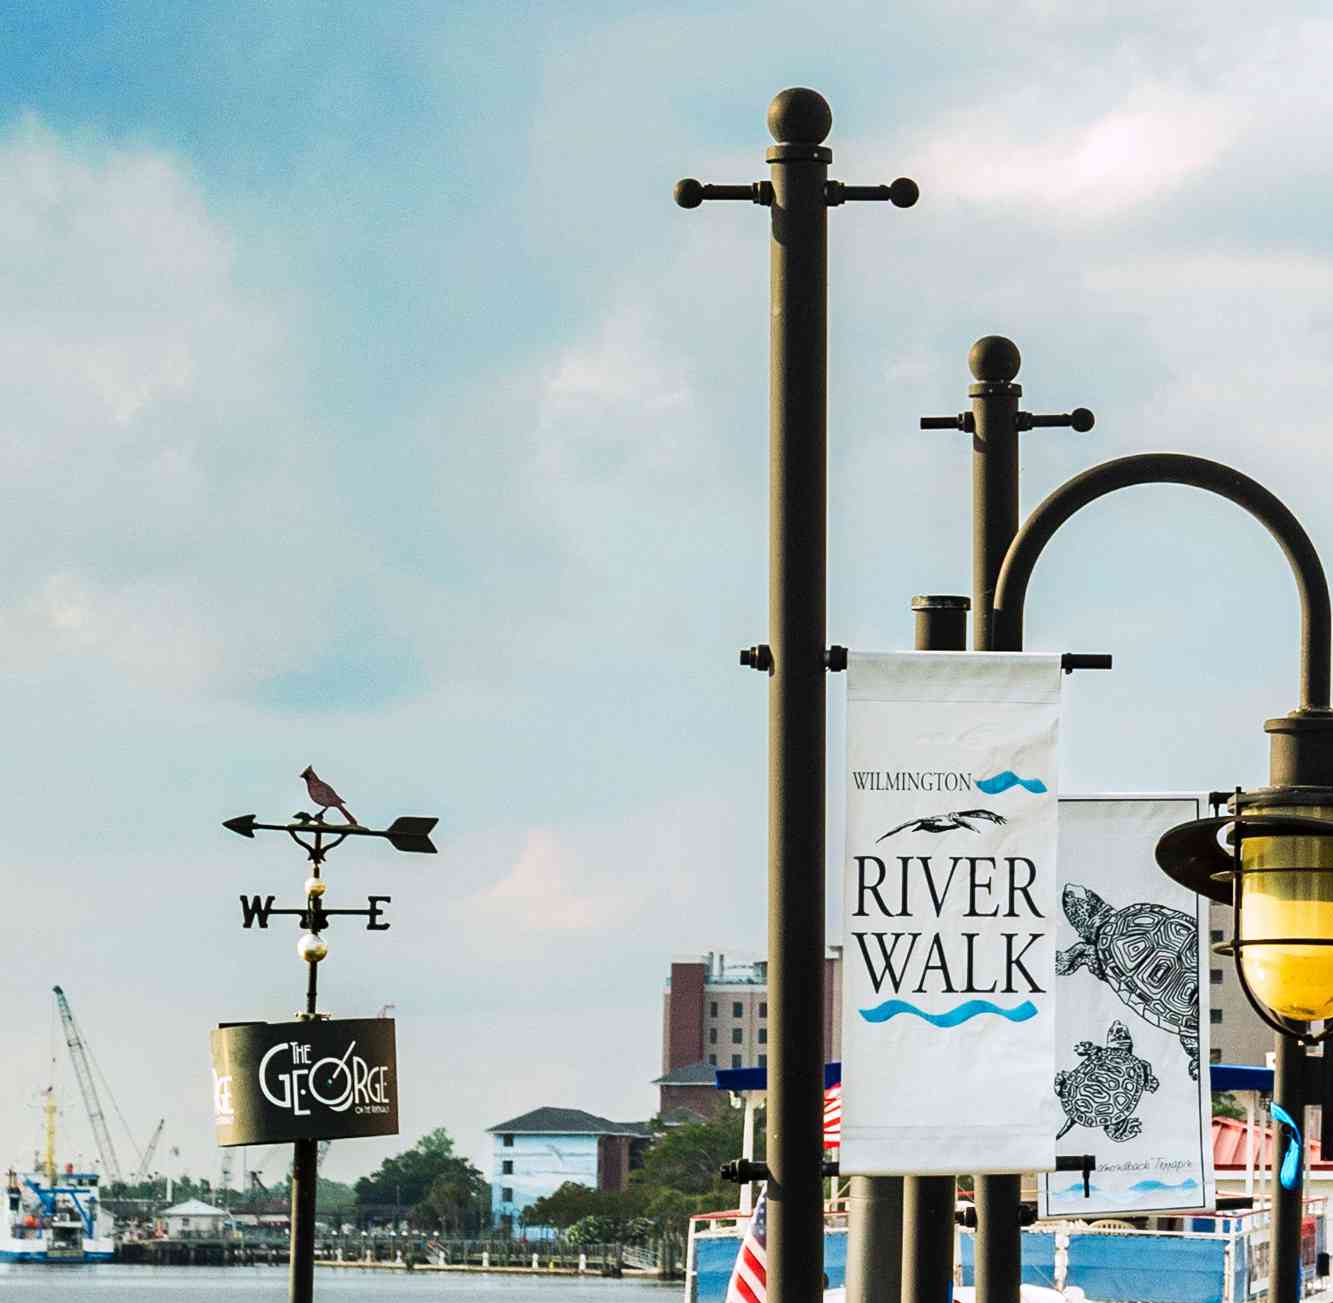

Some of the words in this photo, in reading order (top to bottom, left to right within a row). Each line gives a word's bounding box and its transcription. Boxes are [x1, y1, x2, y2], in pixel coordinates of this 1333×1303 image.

[852, 771, 972, 793] WILMINGTON
[852, 856, 1046, 918] RIVER
[240, 895, 275, 929] W
[366, 896, 391, 930] E
[852, 932, 1046, 994] WALK
[290, 1041, 313, 1065] THE
[258, 1040, 390, 1116] GEORGE
